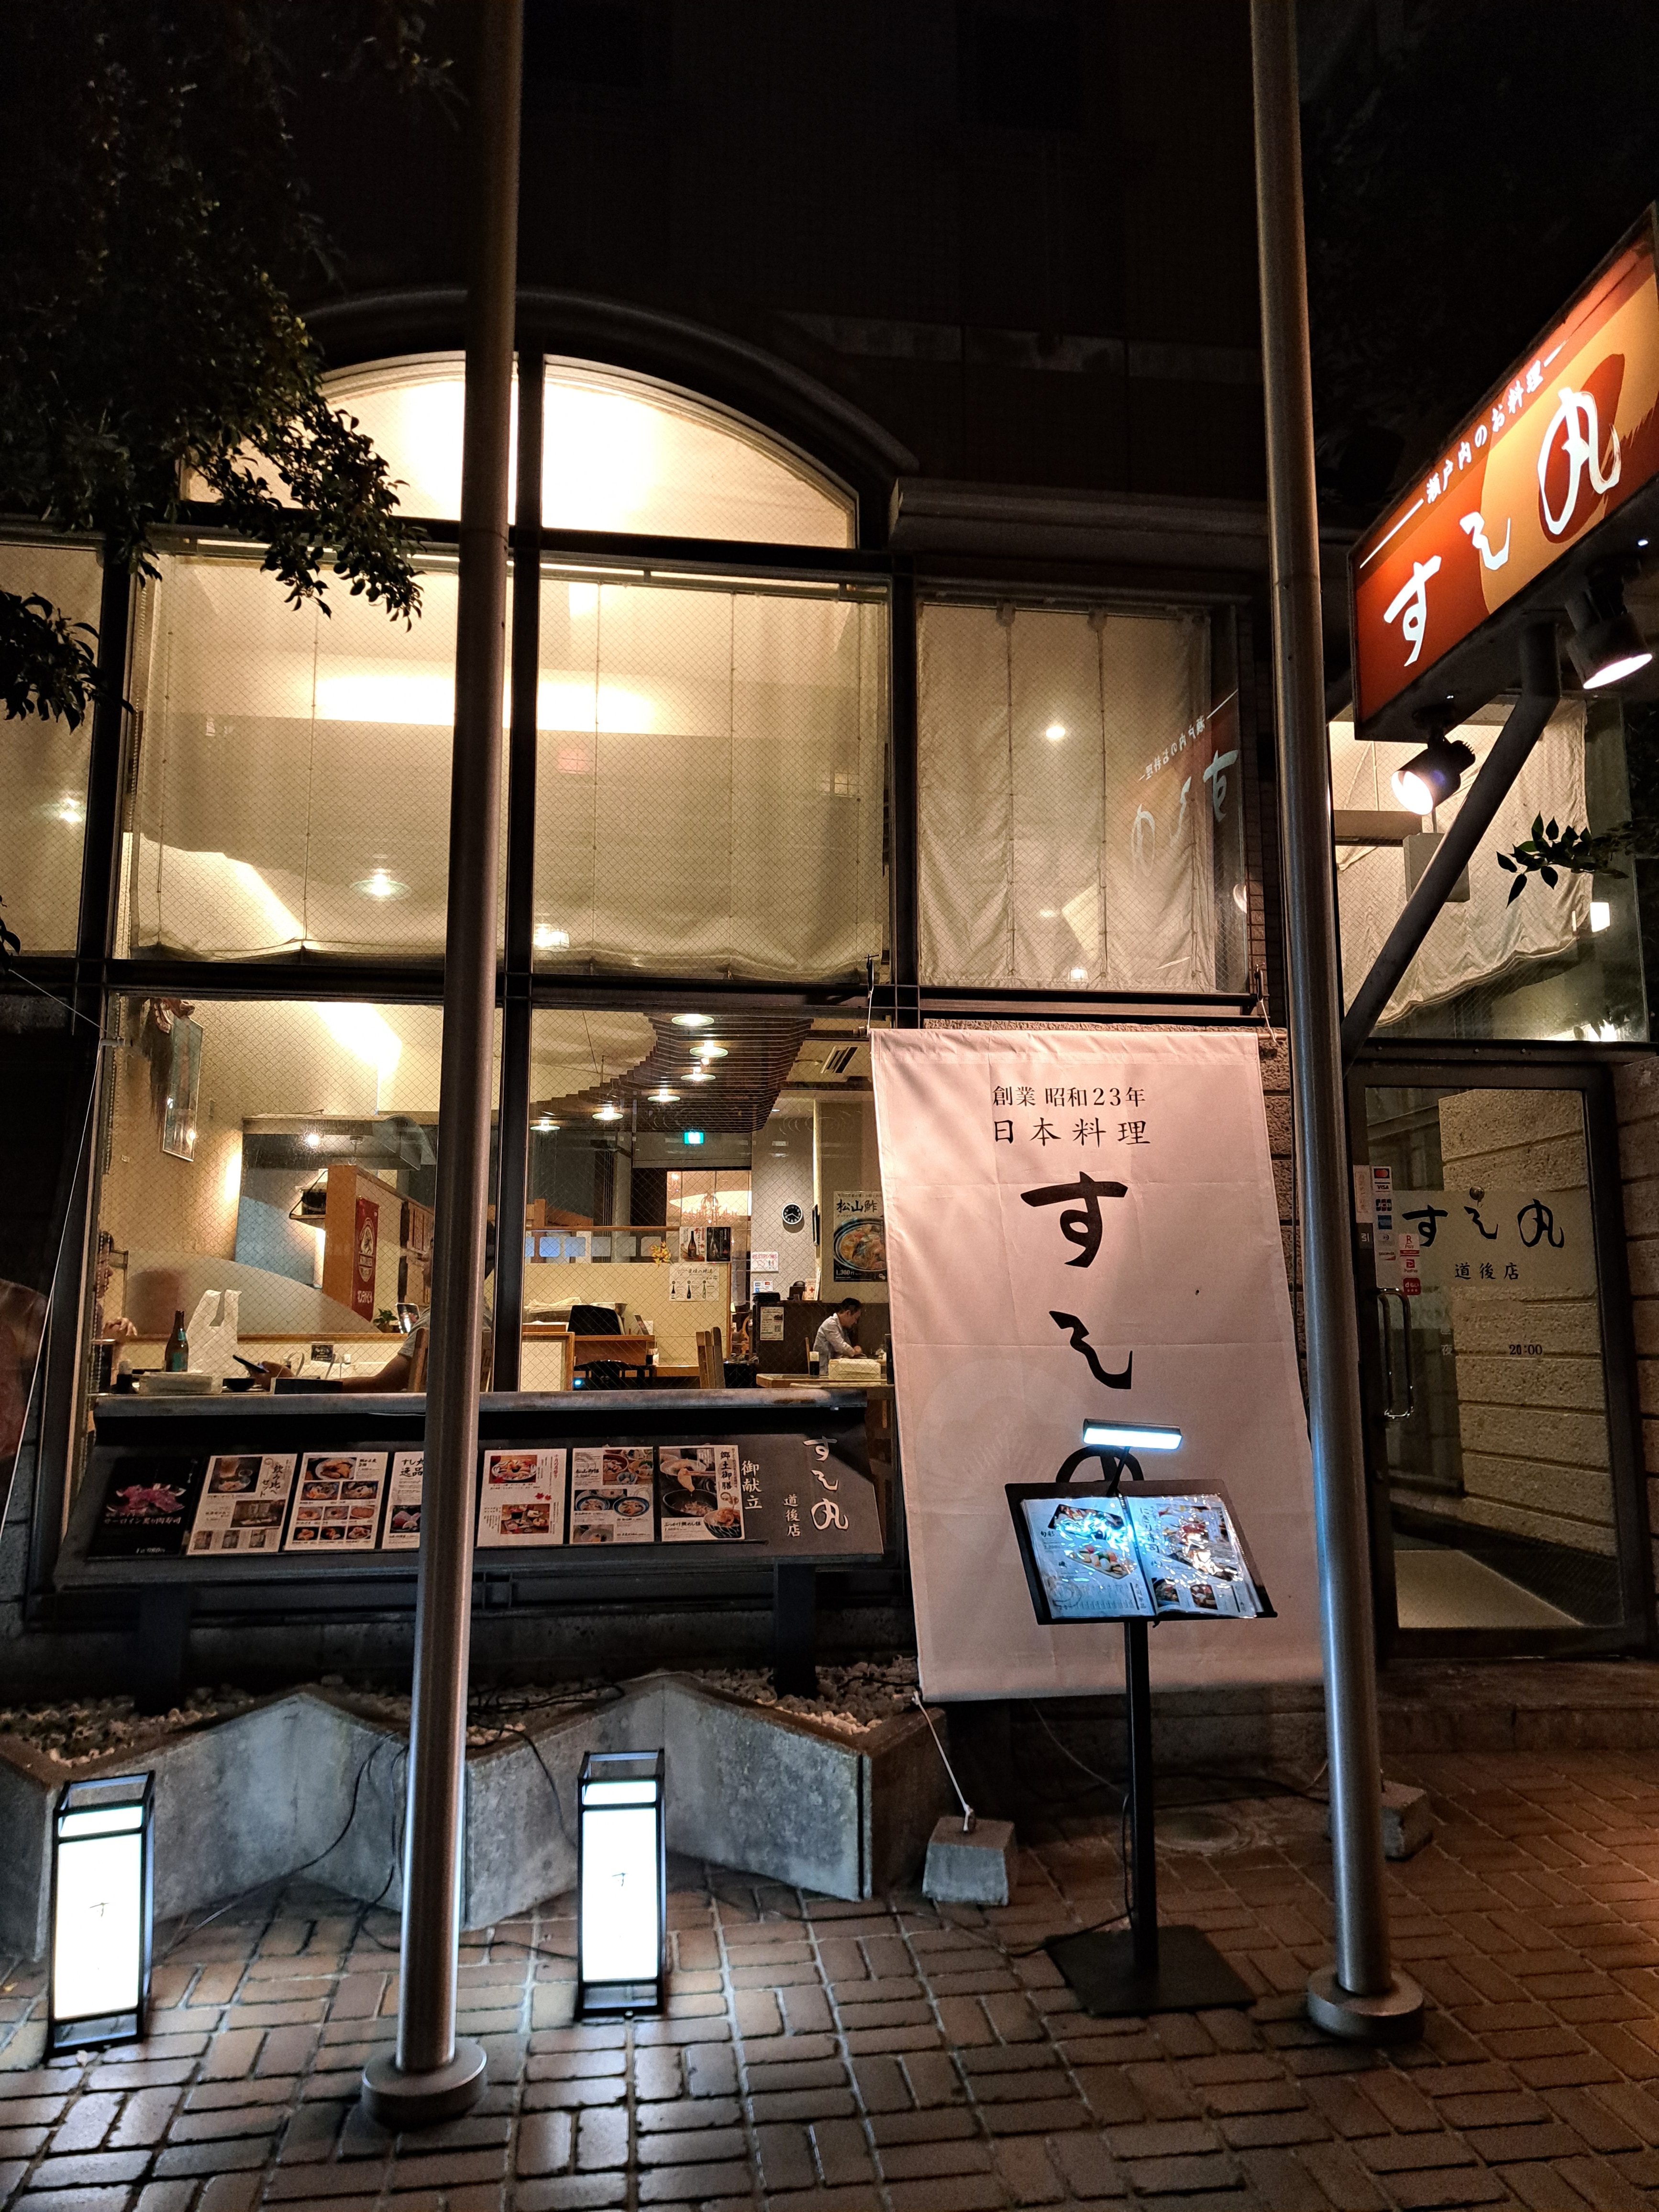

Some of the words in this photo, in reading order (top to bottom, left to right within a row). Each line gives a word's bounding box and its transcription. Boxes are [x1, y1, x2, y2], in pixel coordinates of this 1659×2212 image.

[1427, 360, 1543, 504] 瀬戸内のお料理
[992, 1086, 1036, 1107] 創業
[1045, 1087, 1147, 1107] 昭和23年
[993, 1117, 1151, 1147] 日本料理
[836, 1198, 877, 1213] 松山鮓
[1454, 1262, 1519, 1281] 道後店
[720, 1451, 732, 1490] 郷土御膳
[741, 1460, 763, 1509] 御献立
[783, 1494, 801, 1537] 道後店
